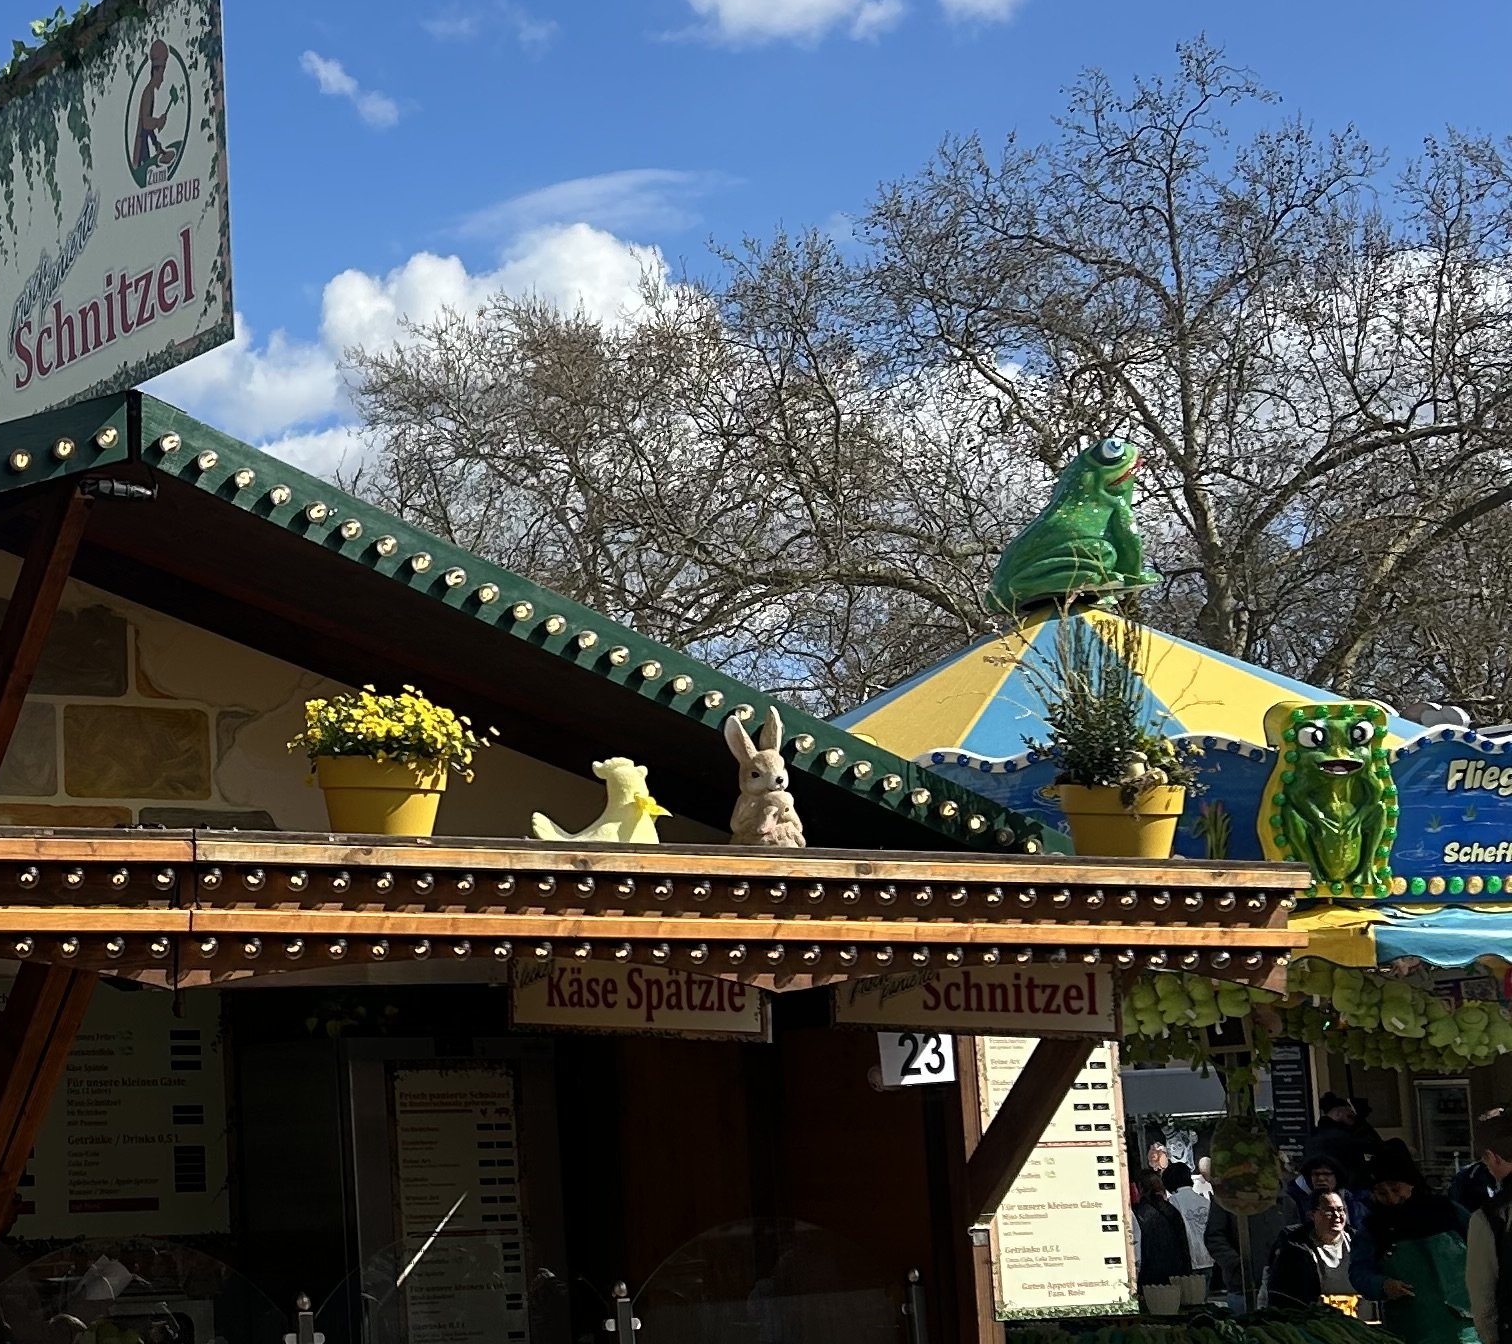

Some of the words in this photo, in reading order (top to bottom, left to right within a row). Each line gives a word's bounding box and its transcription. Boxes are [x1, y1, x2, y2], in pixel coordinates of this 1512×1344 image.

[114, 178, 201, 220] SCHNITZELBUB
[148, 168, 167, 185] Zum
[15, 227, 196, 389] Schnitzel
[546, 967, 619, 1008] Käse
[626, 967, 746, 1022] Spätzle
[922, 970, 1100, 1016] Schnitzel
[898, 1032, 946, 1077] 23
[68, 1135, 112, 1145] Getränke
[122, 1134, 155, 1145] Drinks
